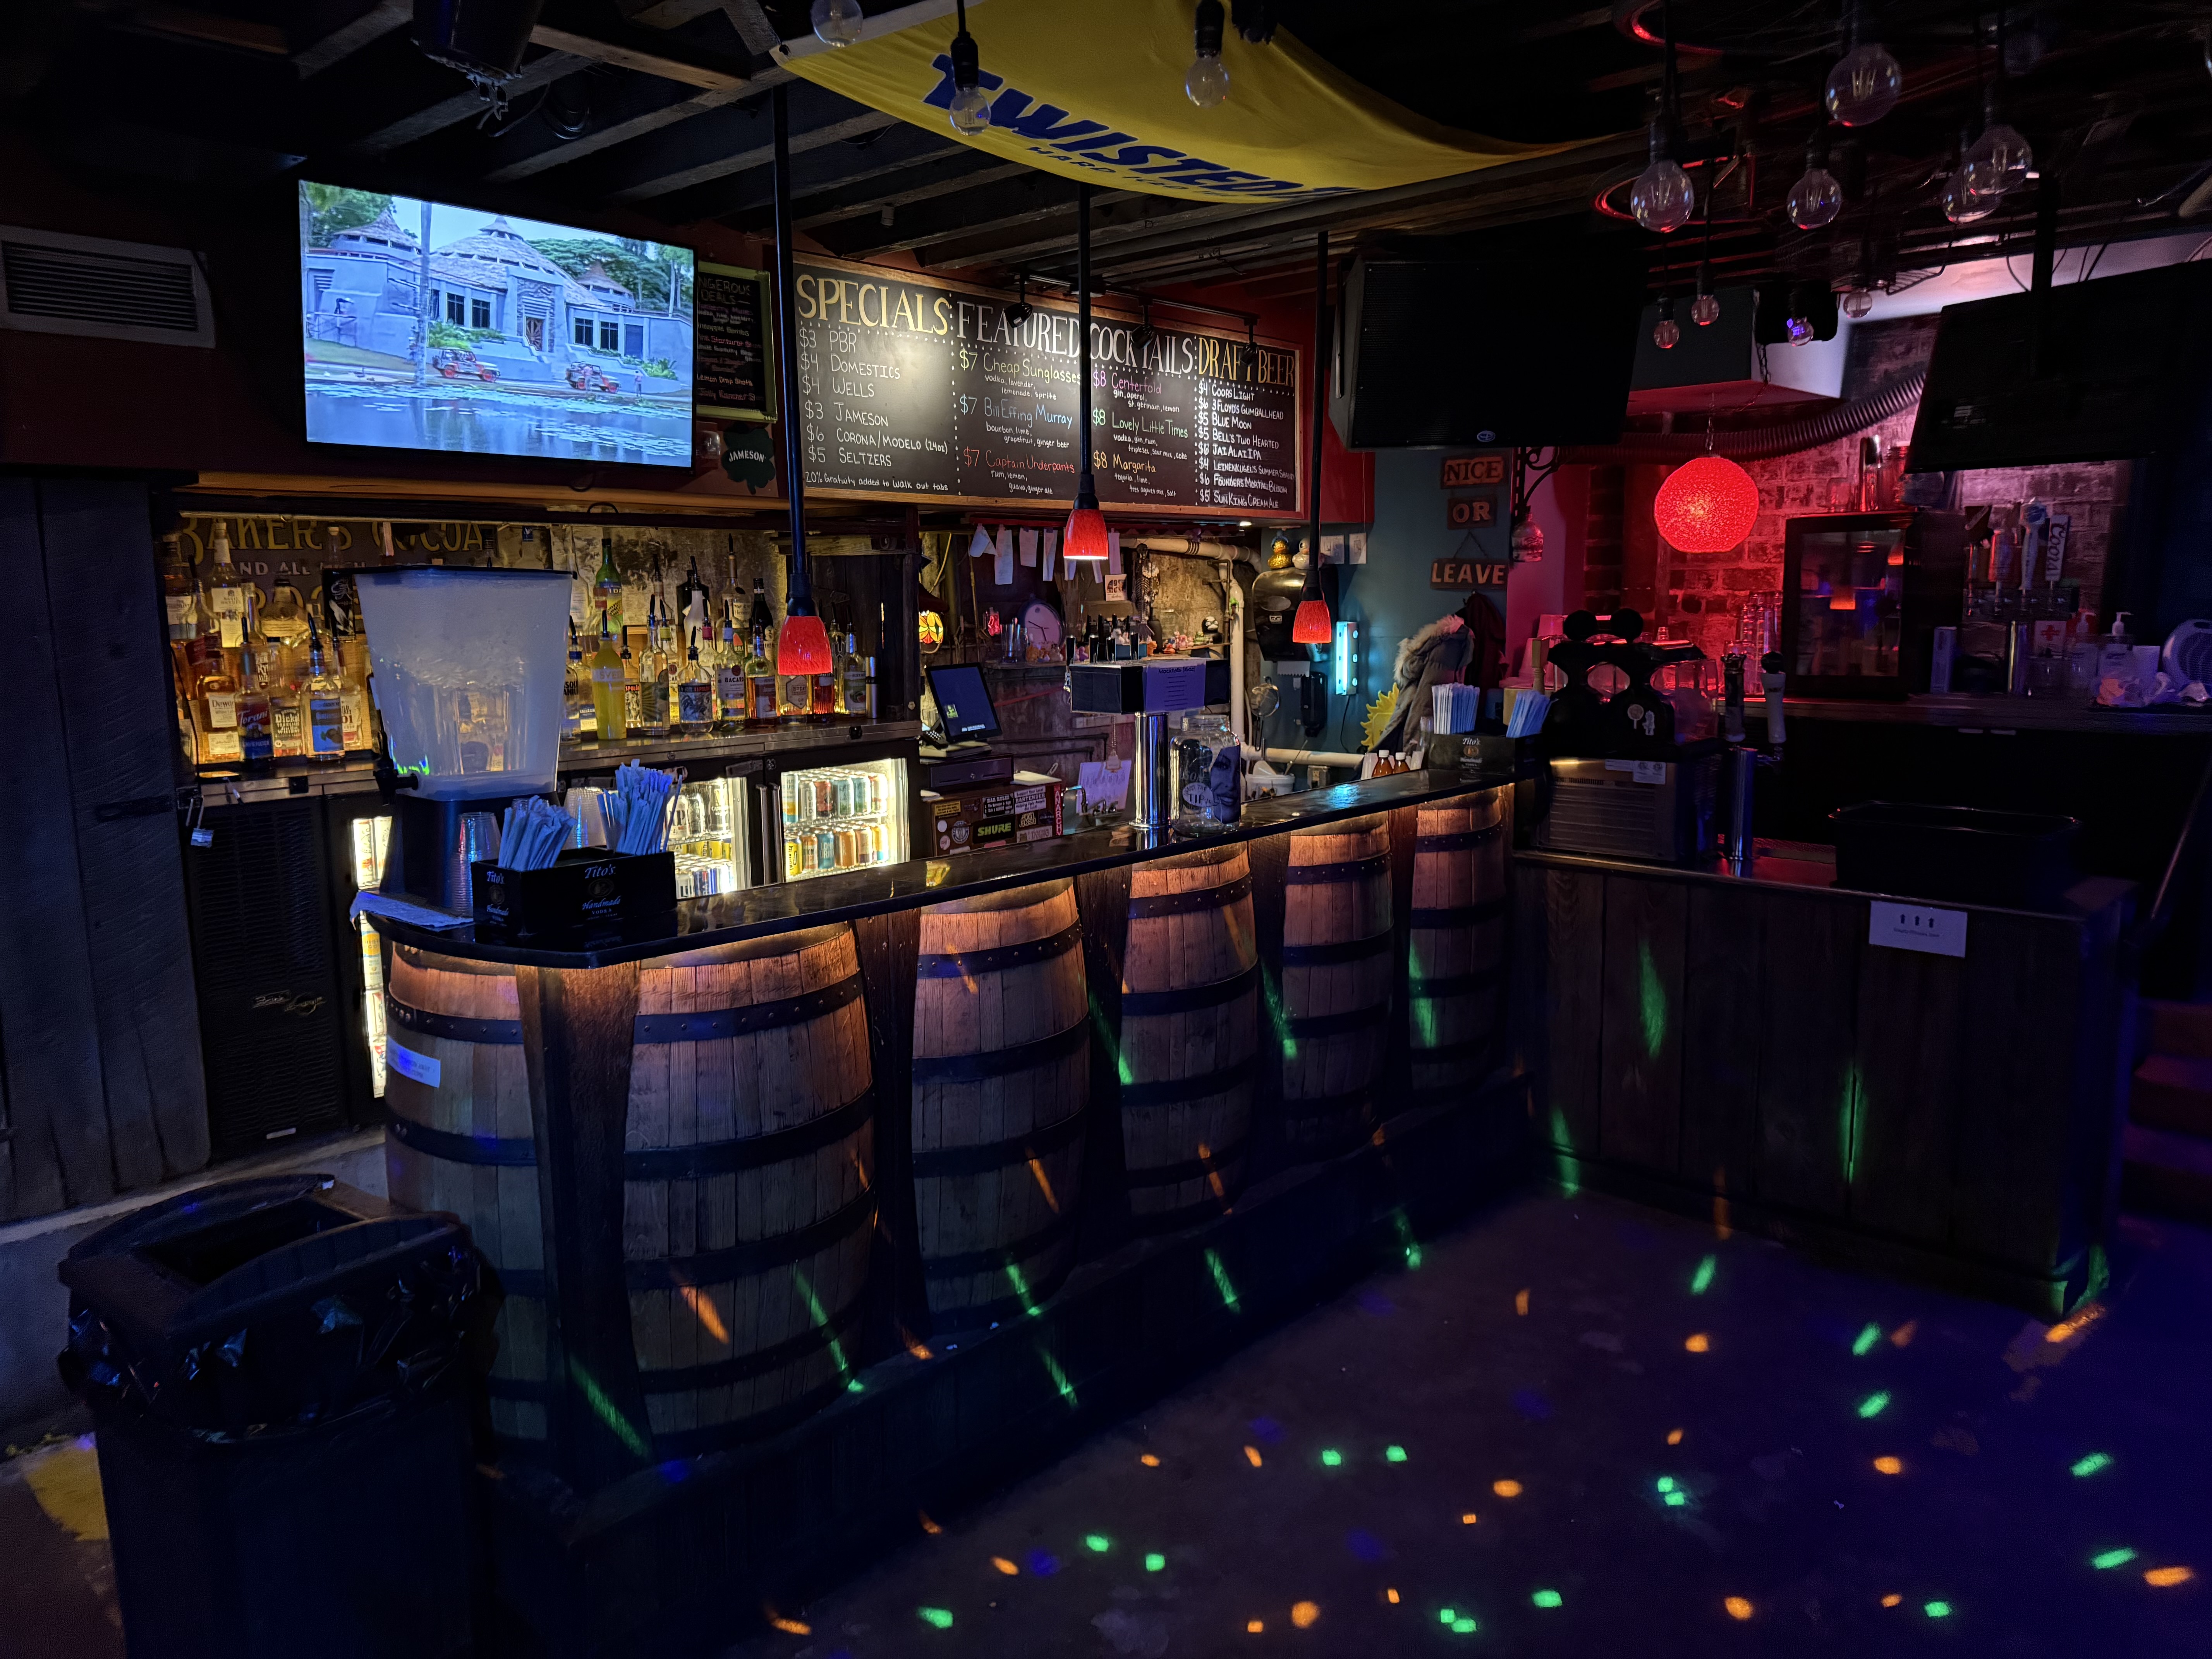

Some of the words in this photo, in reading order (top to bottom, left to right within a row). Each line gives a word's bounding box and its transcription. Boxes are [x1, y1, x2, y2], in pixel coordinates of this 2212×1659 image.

[923, 53, 1304, 192] TWISTED
[796, 274, 950, 335] SPECIALS
[800, 326, 816, 348] $3
[830, 331, 857, 354] PBR
[800, 352, 819, 373] $4
[831, 353, 900, 379] DOMESTICS
[959, 347, 978, 371] $7
[983, 353, 1020, 378] Cheap
[1022, 359, 1080, 385] Sunglasses
[1258, 349, 1295, 387] BEER
[802, 373, 820, 395] $4
[832, 376, 875, 398] WELLS
[984, 374, 1007, 385] vodka,
[1008, 379, 1036, 390] lavender,
[1093, 368, 1106, 389] $8
[1111, 372, 1162, 394] Centerfold
[1198, 380, 1208, 396] $4
[1211, 383, 1233, 398] COORS
[1233, 387, 1255, 401] LIGHT
[805, 399, 824, 420] $3
[834, 402, 889, 427] JAMESON
[960, 393, 977, 415] $7
[984, 397, 999, 417] Bill
[1001, 399, 1032, 428] Effing
[1036, 403, 1072, 429] Murray
[1163, 404, 1180, 412] lemon
[1198, 396, 1209, 410] $6
[1240, 403, 1284, 420] GUMBALLHEAD
[1092, 407, 1106, 426] $8
[1112, 410, 1140, 435] Lovely
[1142, 416, 1165, 434] Little
[1164, 419, 1188, 438] Times
[1198, 410, 1209, 426] $5
[1212, 412, 1230, 428] BLUE
[1231, 415, 1252, 429] MOON
[807, 422, 824, 443] $6
[1016, 426, 1032, 437] lime,
[1198, 425, 1209, 441] $5
[1212, 427, 1235, 444] BELL'S
[1236, 434, 1250, 445] TWO
[1252, 434, 1279, 449] HEARTED
[1036, 438, 1055, 448] ginger
[1056, 439, 1070, 448] beer
[1212, 444, 1228, 456] JAI
[1247, 448, 1262, 461] IPA
[729, 449, 765, 463] JAMESON
[808, 444, 826, 463] $5
[839, 447, 892, 467] SELTZERS
[963, 446, 980, 467] $7
[985, 450, 1025, 470] Captain
[1026, 454, 1075, 474] Underpants
[1093, 449, 1108, 470] $8
[1113, 453, 1156, 474] Margarita
[1199, 456, 1209, 471] $4
[805, 471, 823, 484] 20%
[824, 472, 855, 487] Gratuity
[859, 477, 880, 486] added
[916, 481, 929, 490] out
[933, 483, 948, 491] tabs
[991, 470, 1006, 480] rum,
[1007, 472, 1028, 481] lemon,
[1199, 471, 1210, 486] $6
[1446, 460, 1502, 481] NICE
[1027, 485, 1044, 494] ginger
[1200, 488, 1211, 502] $5
[1269, 497, 1279, 509] ALE
[1452, 501, 1491, 523] OR
[1432, 562, 1506, 584] LEAVE
[237, 709, 268, 728] Torani
[1462, 737, 1480, 745] Tito's
[977, 822, 1012, 837] SHURE
[486, 871, 505, 884] Tito's
[584, 864, 616, 879] Tito's
[582, 895, 622, 910] Handmade
